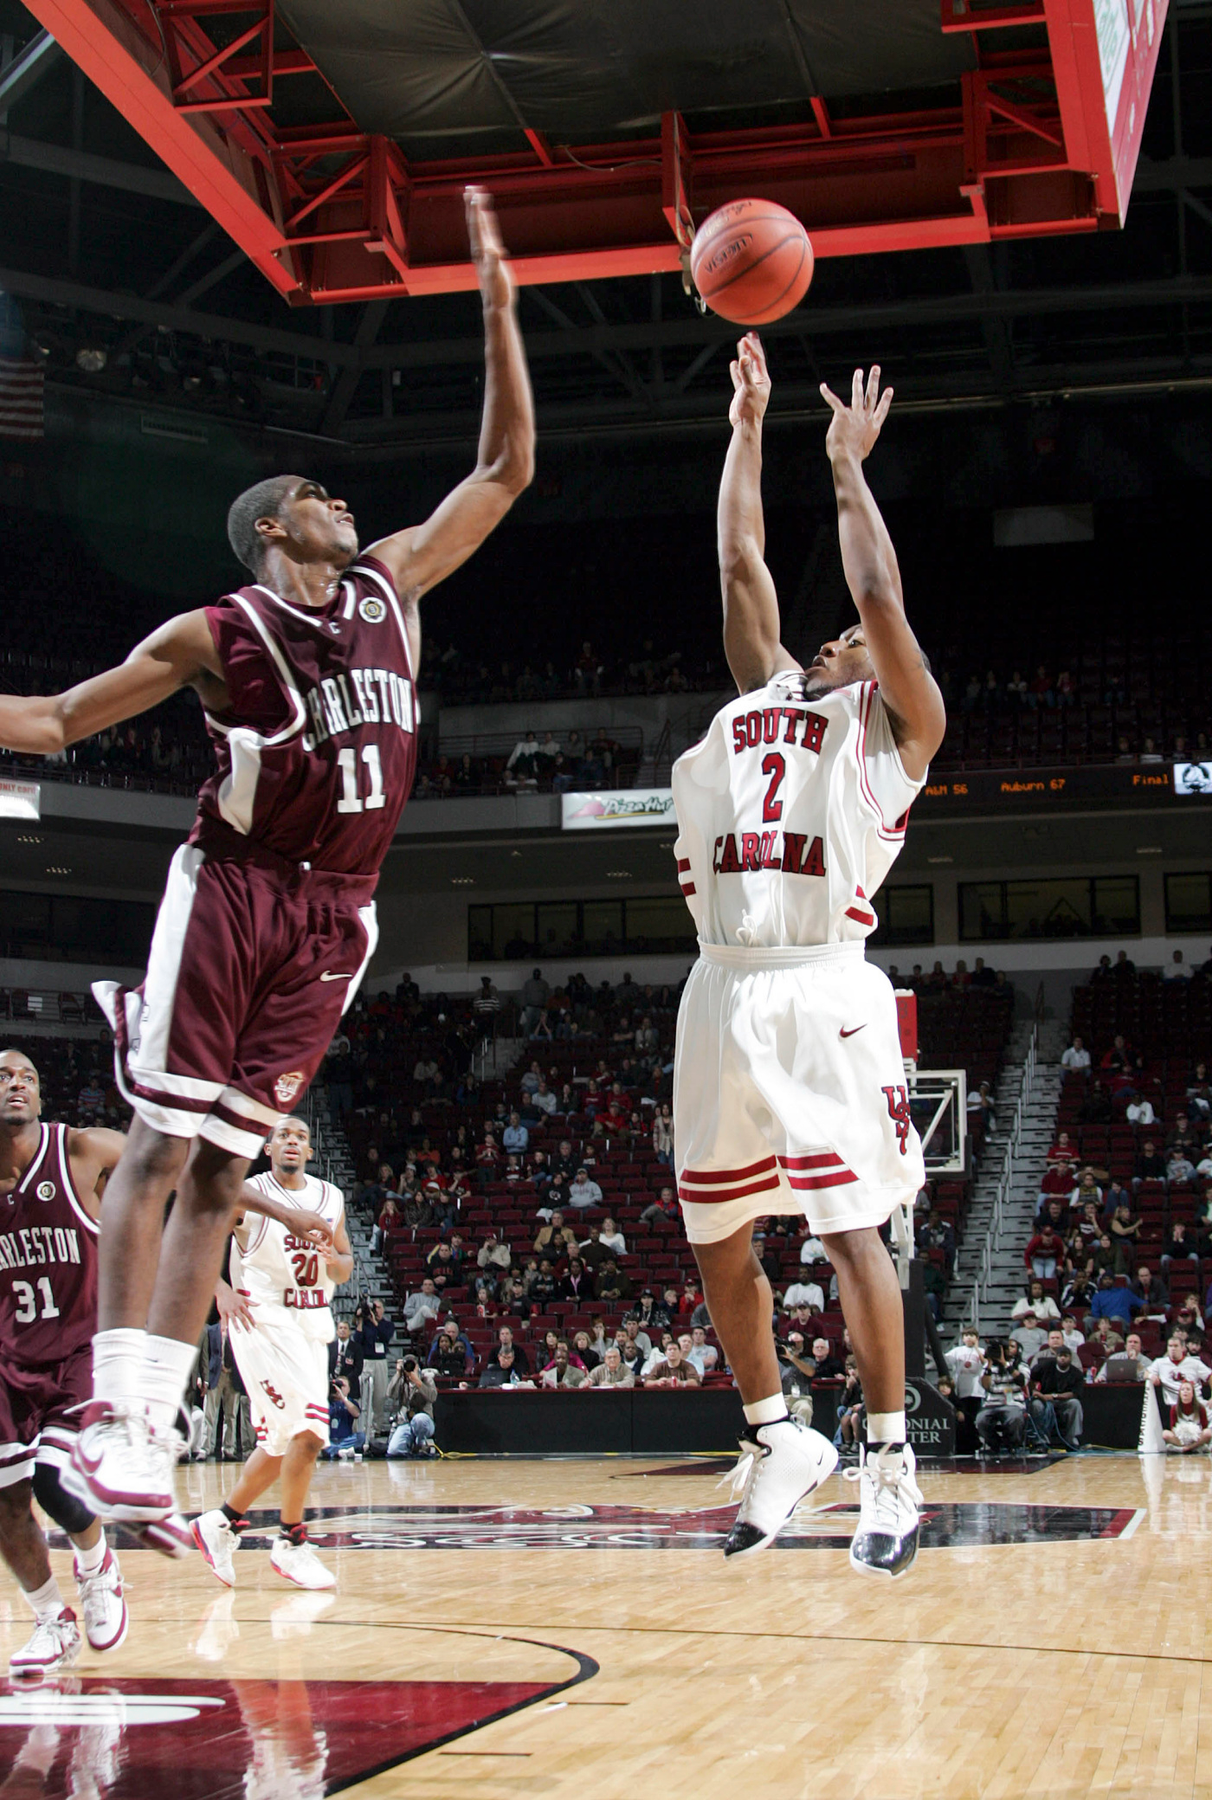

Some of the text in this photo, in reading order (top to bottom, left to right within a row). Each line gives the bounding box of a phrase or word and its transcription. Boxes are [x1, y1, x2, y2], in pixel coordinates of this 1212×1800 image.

[301, 667, 413, 752] HRLESTON
[732, 707, 829, 754] SOUTH
[337, 744, 386, 813] 11
[761, 751, 786, 824] 2
[953, 783, 969, 795] 56
[1001, 781, 1045, 792] Auburn
[1050, 778, 1066, 790] 67
[1133, 773, 1169, 786] Final
[713, 831, 826, 877] CAROLNA
[284, 1234, 322, 1252] SOU
[292, 1253, 319, 1287] 20
[12, 1276, 60, 1323] 31
